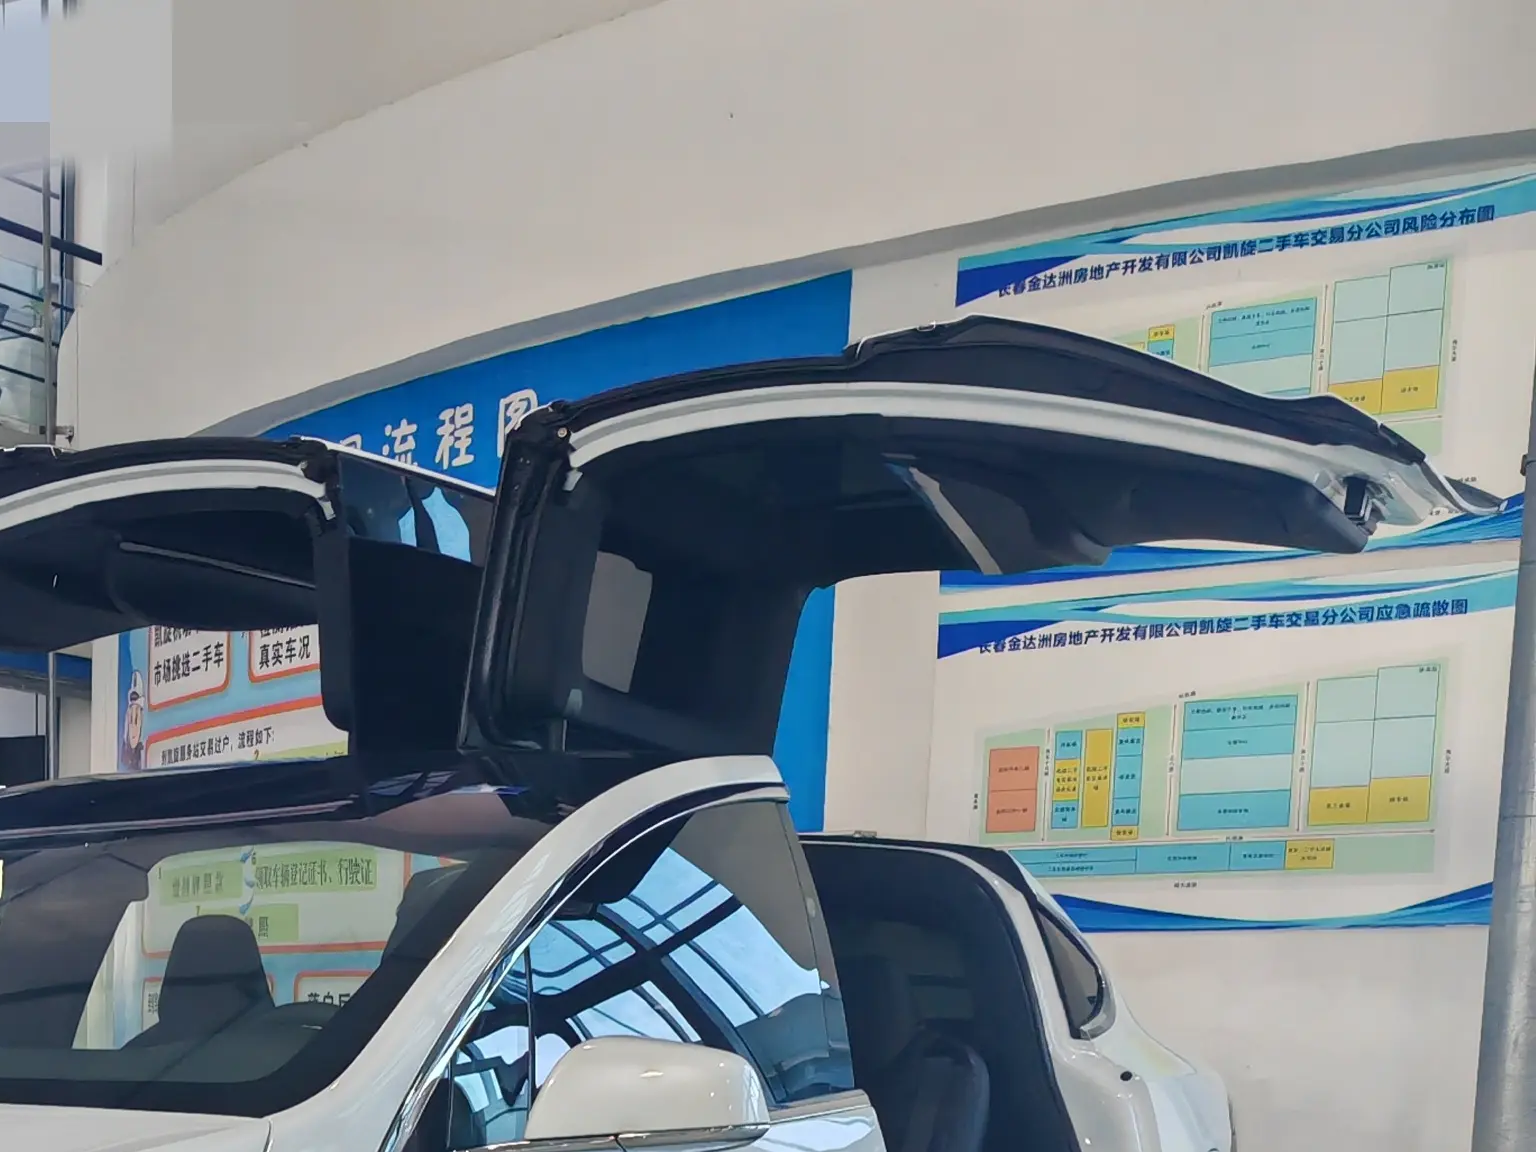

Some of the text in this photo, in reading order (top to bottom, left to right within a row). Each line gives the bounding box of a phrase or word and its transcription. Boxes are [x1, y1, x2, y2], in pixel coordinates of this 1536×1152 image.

[154, 641, 224, 687] 市场挑选二手车
[259, 635, 311, 670] 真实车况
